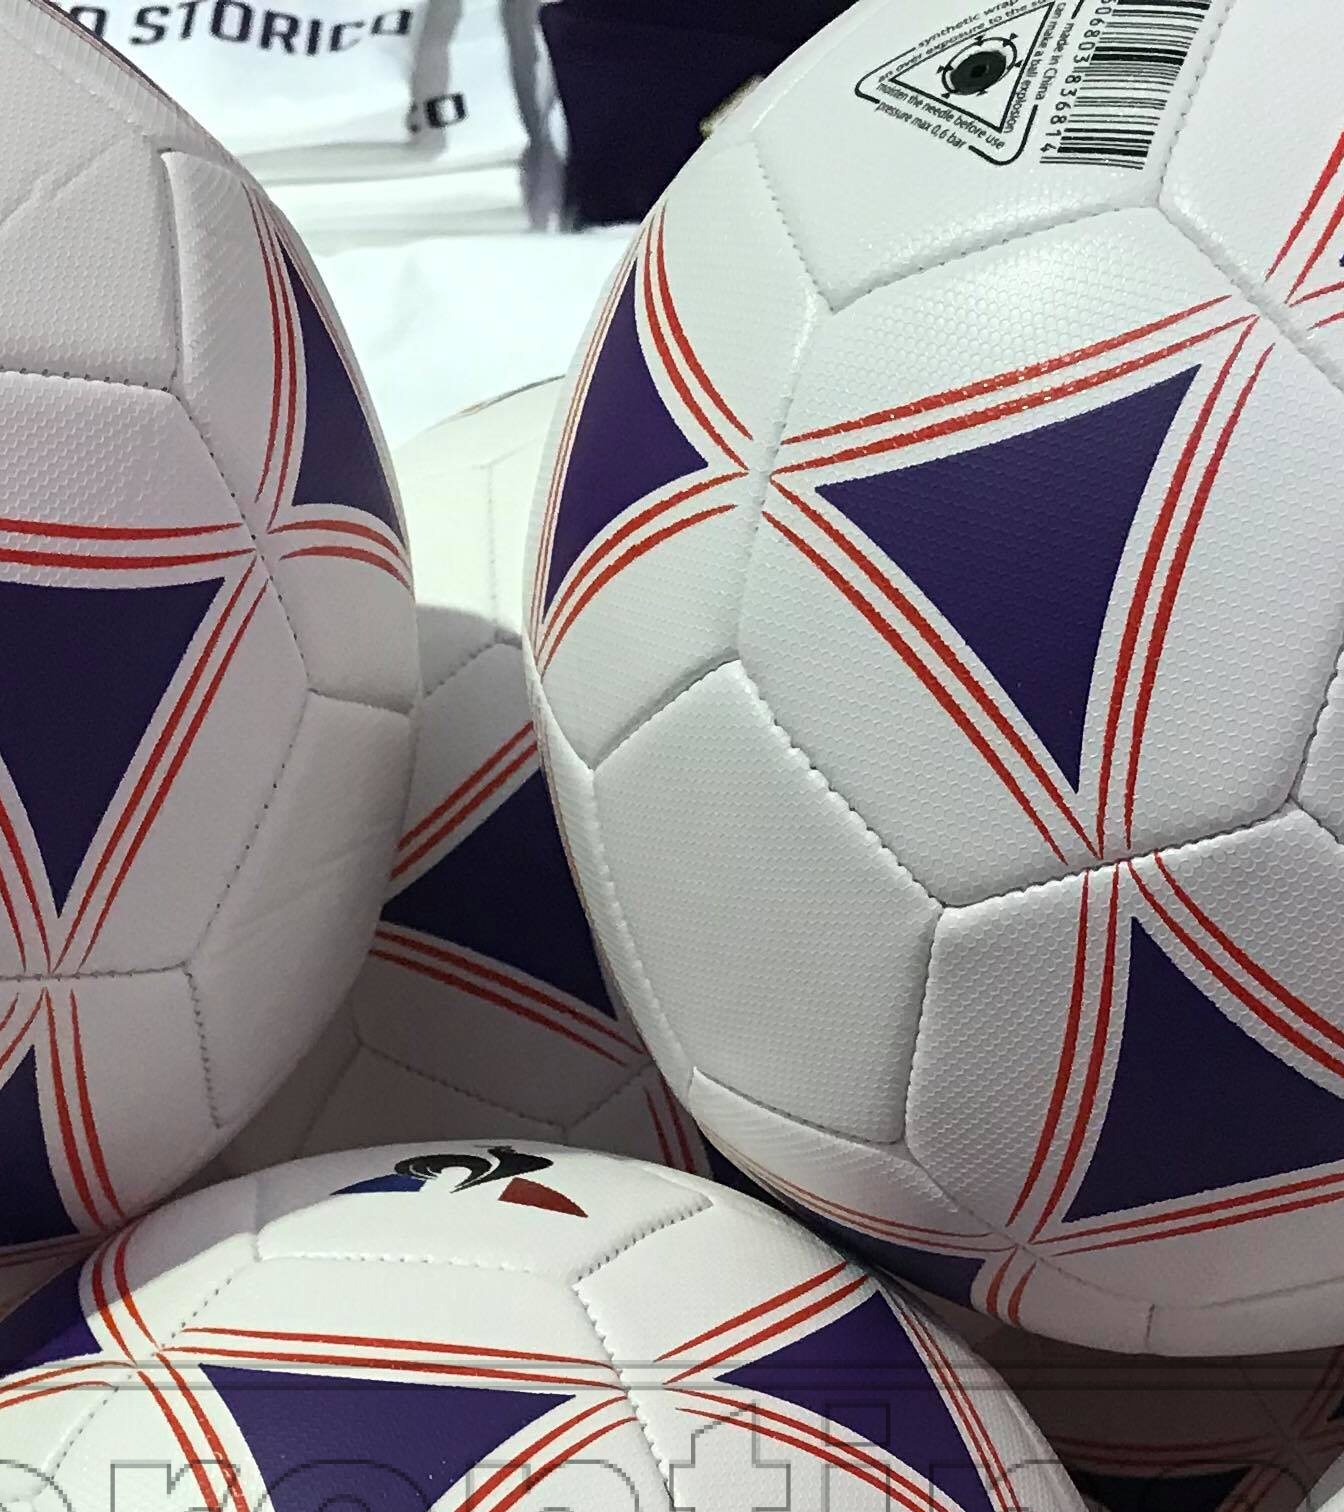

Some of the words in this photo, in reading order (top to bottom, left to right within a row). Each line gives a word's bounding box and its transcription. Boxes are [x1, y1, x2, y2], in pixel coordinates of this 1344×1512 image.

[129, 0, 412, 56] STORICO
[1054, 22, 1074, 53] made
[1003, 79, 1032, 134] explosion
[1035, 67, 1058, 101] China
[875, 101, 913, 122] pressure
[911, 116, 933, 132] max
[946, 131, 967, 149] bar
[922, 101, 955, 122] needle
[953, 115, 987, 139] before
[985, 133, 1006, 150] use
